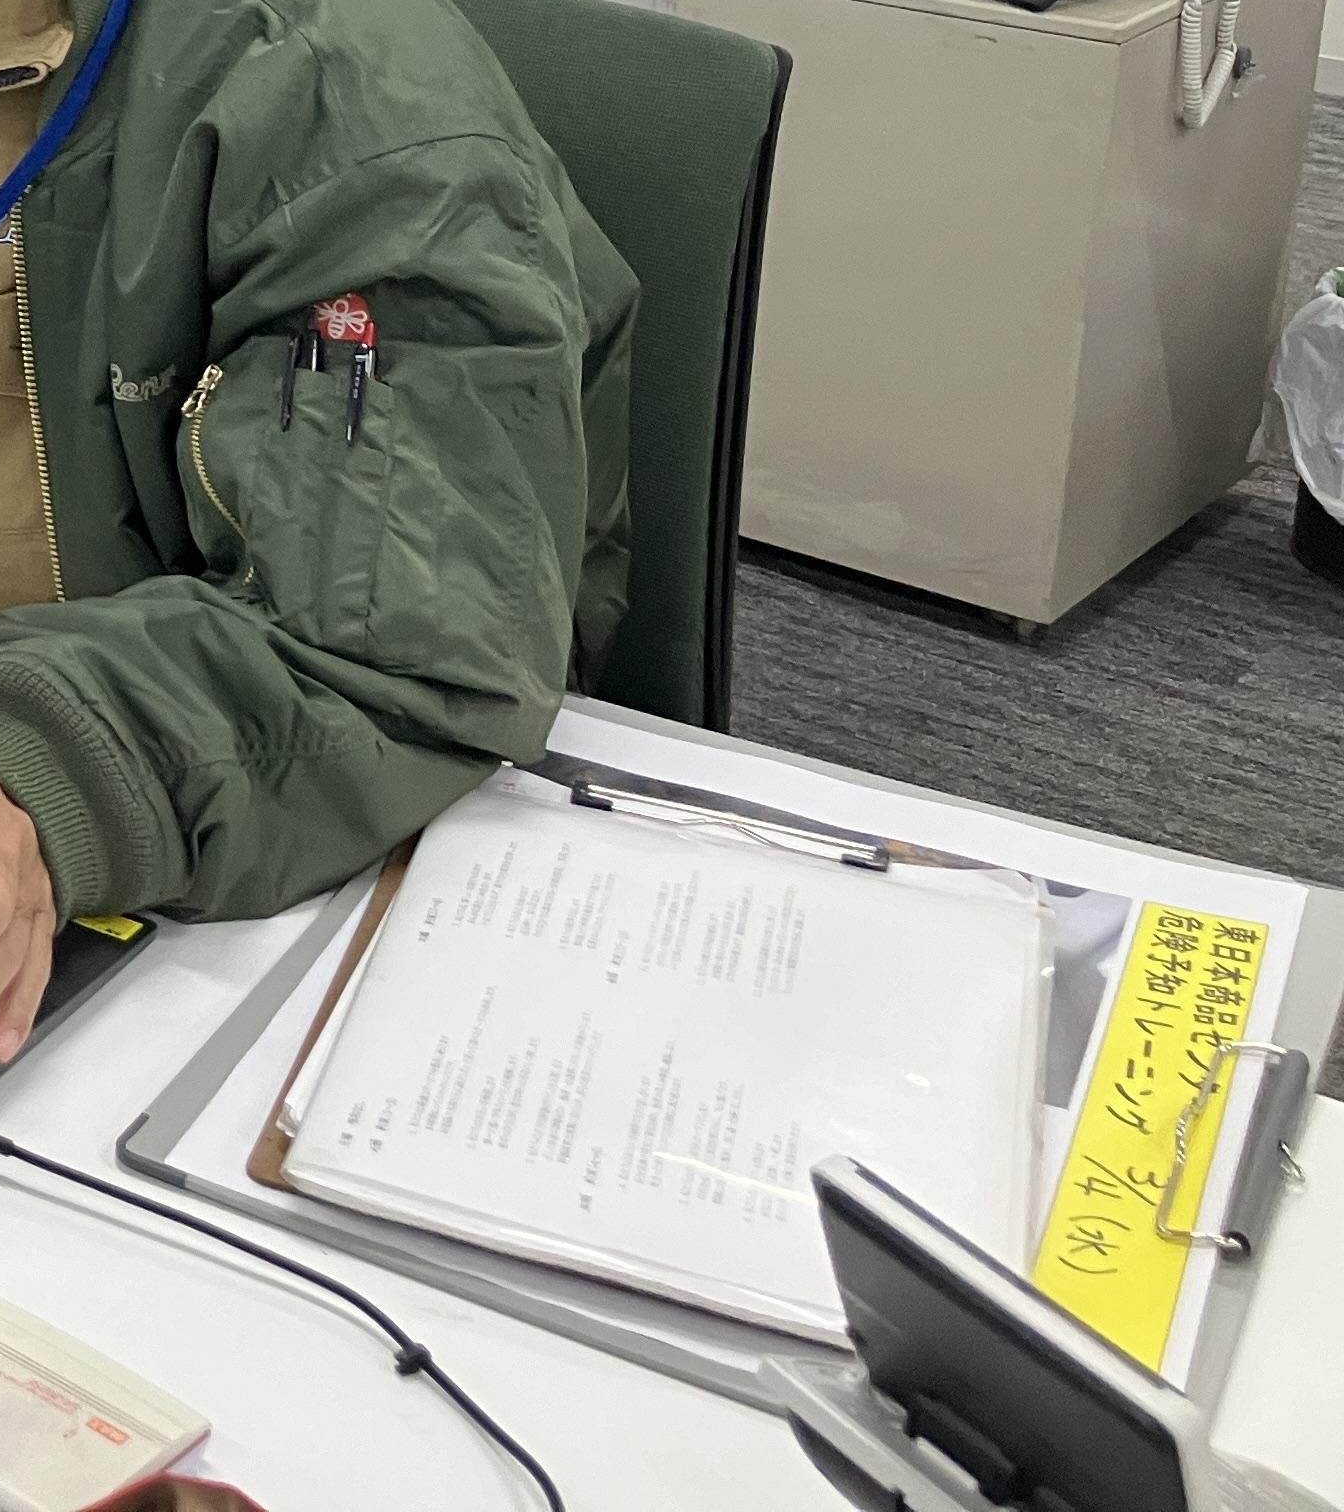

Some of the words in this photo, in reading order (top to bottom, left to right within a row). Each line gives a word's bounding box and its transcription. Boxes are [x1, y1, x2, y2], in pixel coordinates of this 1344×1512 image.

[1176, 919, 1263, 1118] 東日本商品センタ
